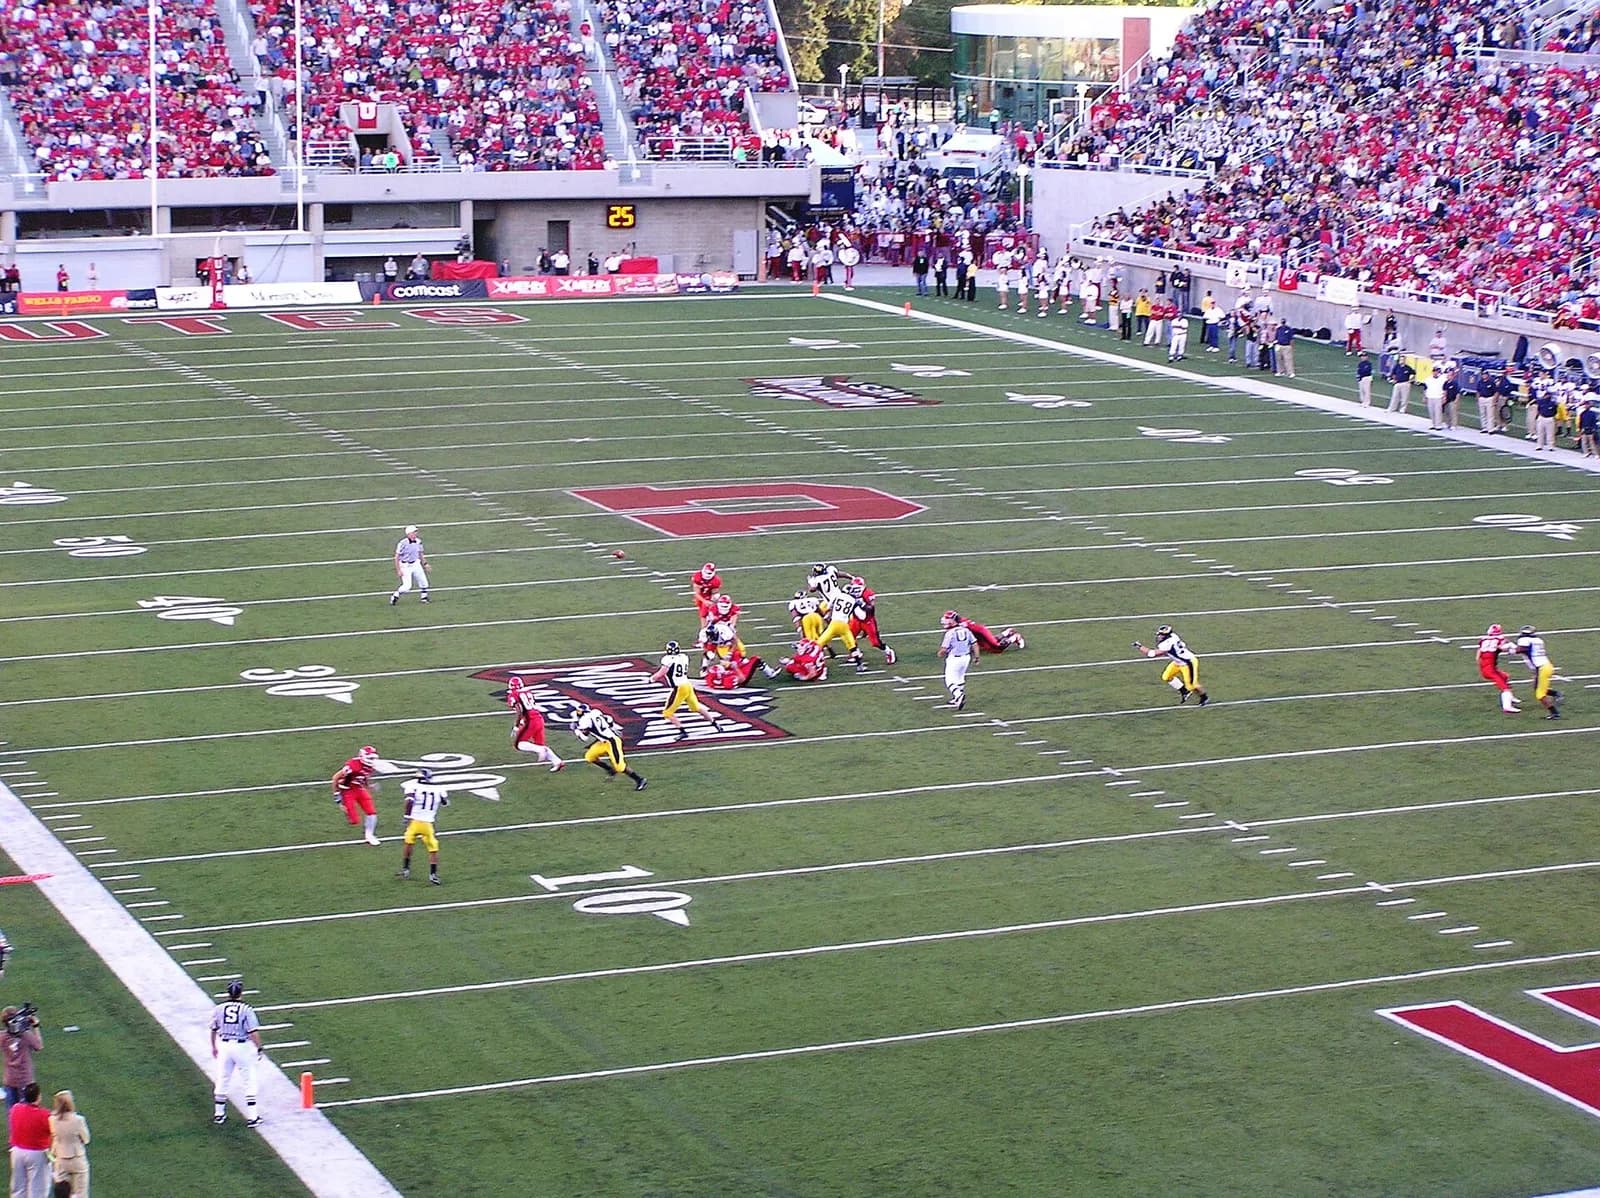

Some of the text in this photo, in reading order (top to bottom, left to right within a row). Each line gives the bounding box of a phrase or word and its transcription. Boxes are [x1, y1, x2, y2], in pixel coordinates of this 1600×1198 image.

[609, 206, 634, 227] 25
[393, 284, 463, 298] comcast
[1294, 468, 1394, 485] 50
[1473, 513, 1583, 534] 40
[53, 535, 148, 558] 50
[823, 574, 839, 593] 76
[136, 596, 243, 621] 40
[835, 598, 854, 615] 58
[240, 664, 361, 697] 30
[421, 791, 435, 811] 11
[530, 865, 694, 914] 10
[224, 1005, 239, 1023] S
